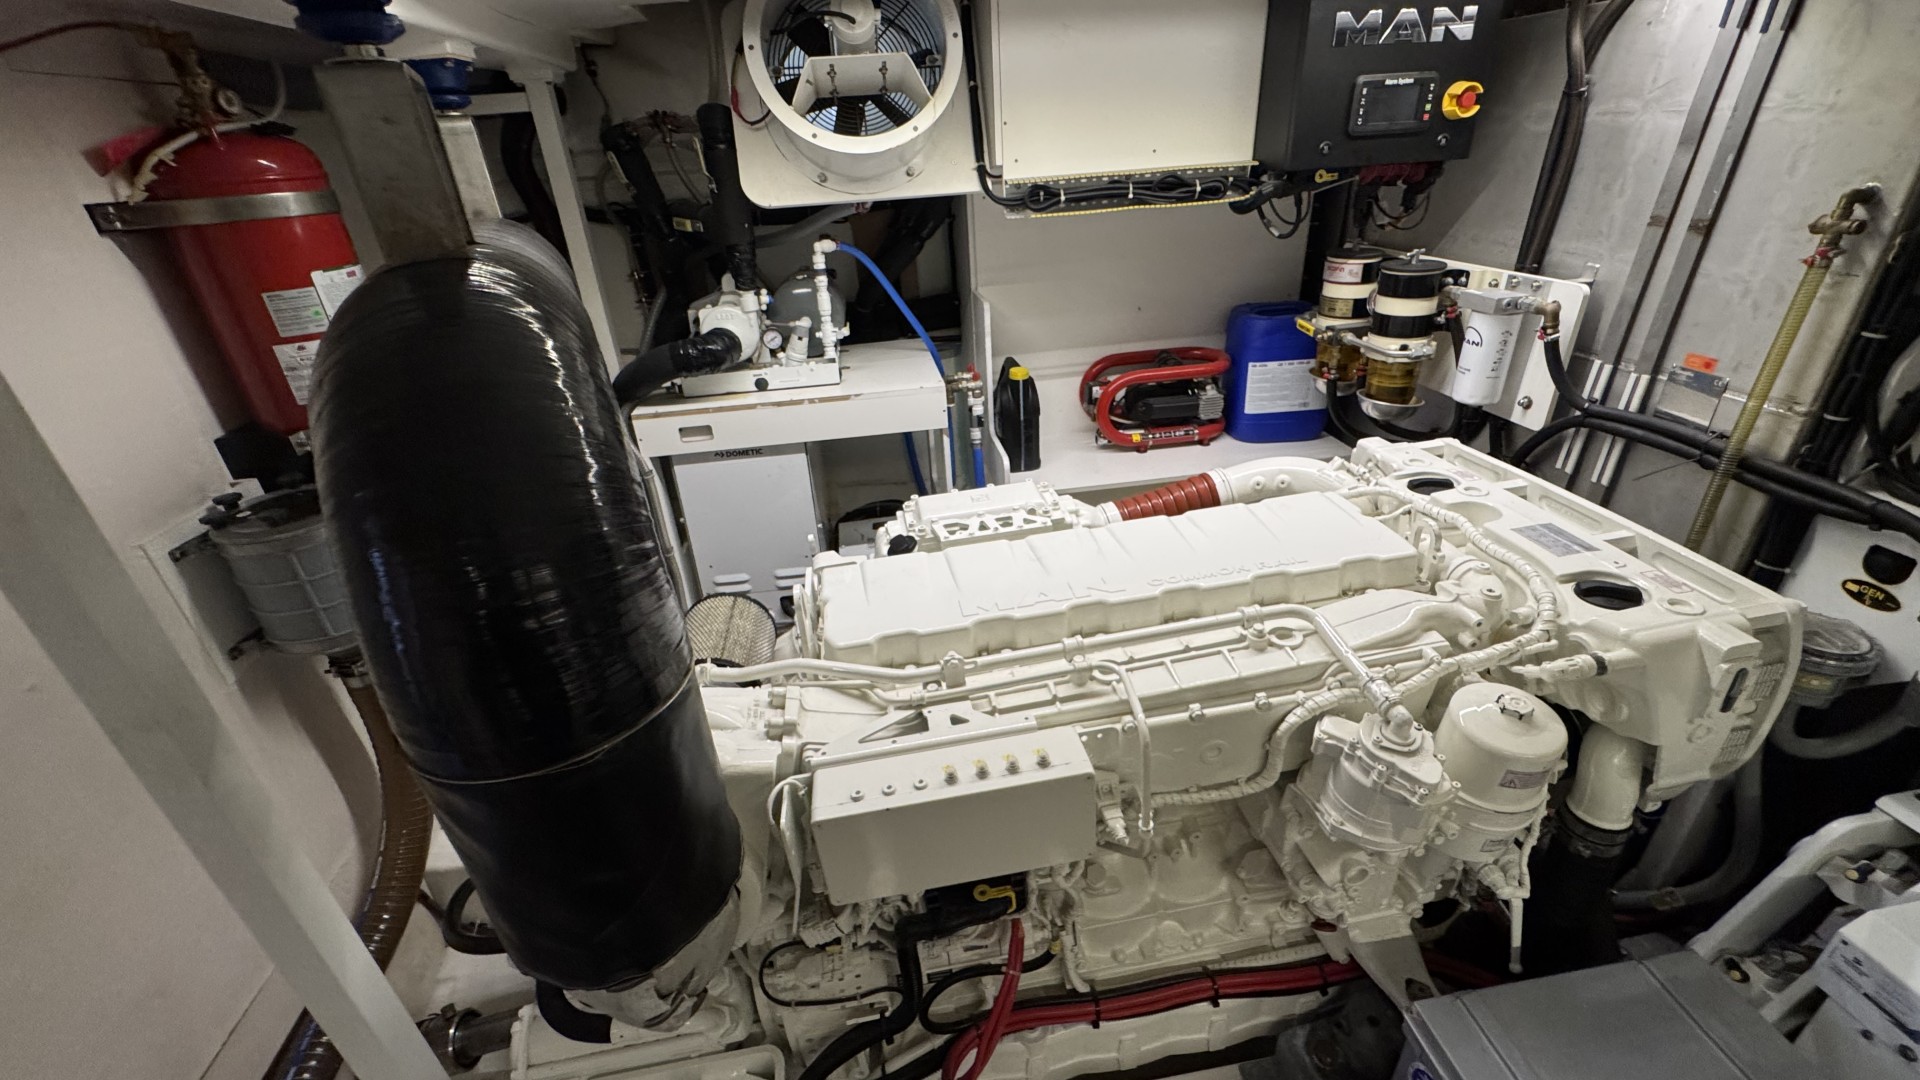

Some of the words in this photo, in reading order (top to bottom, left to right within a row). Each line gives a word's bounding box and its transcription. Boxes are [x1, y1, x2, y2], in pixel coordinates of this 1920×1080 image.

[1332, 5, 1479, 47] MAN
[1464, 338, 1480, 347] AN
[726, 448, 763, 458] DOMETIC
[1147, 567, 1251, 587] COMMON
[1255, 557, 1309, 571] RAIL
[1860, 585, 1885, 601] GEN
